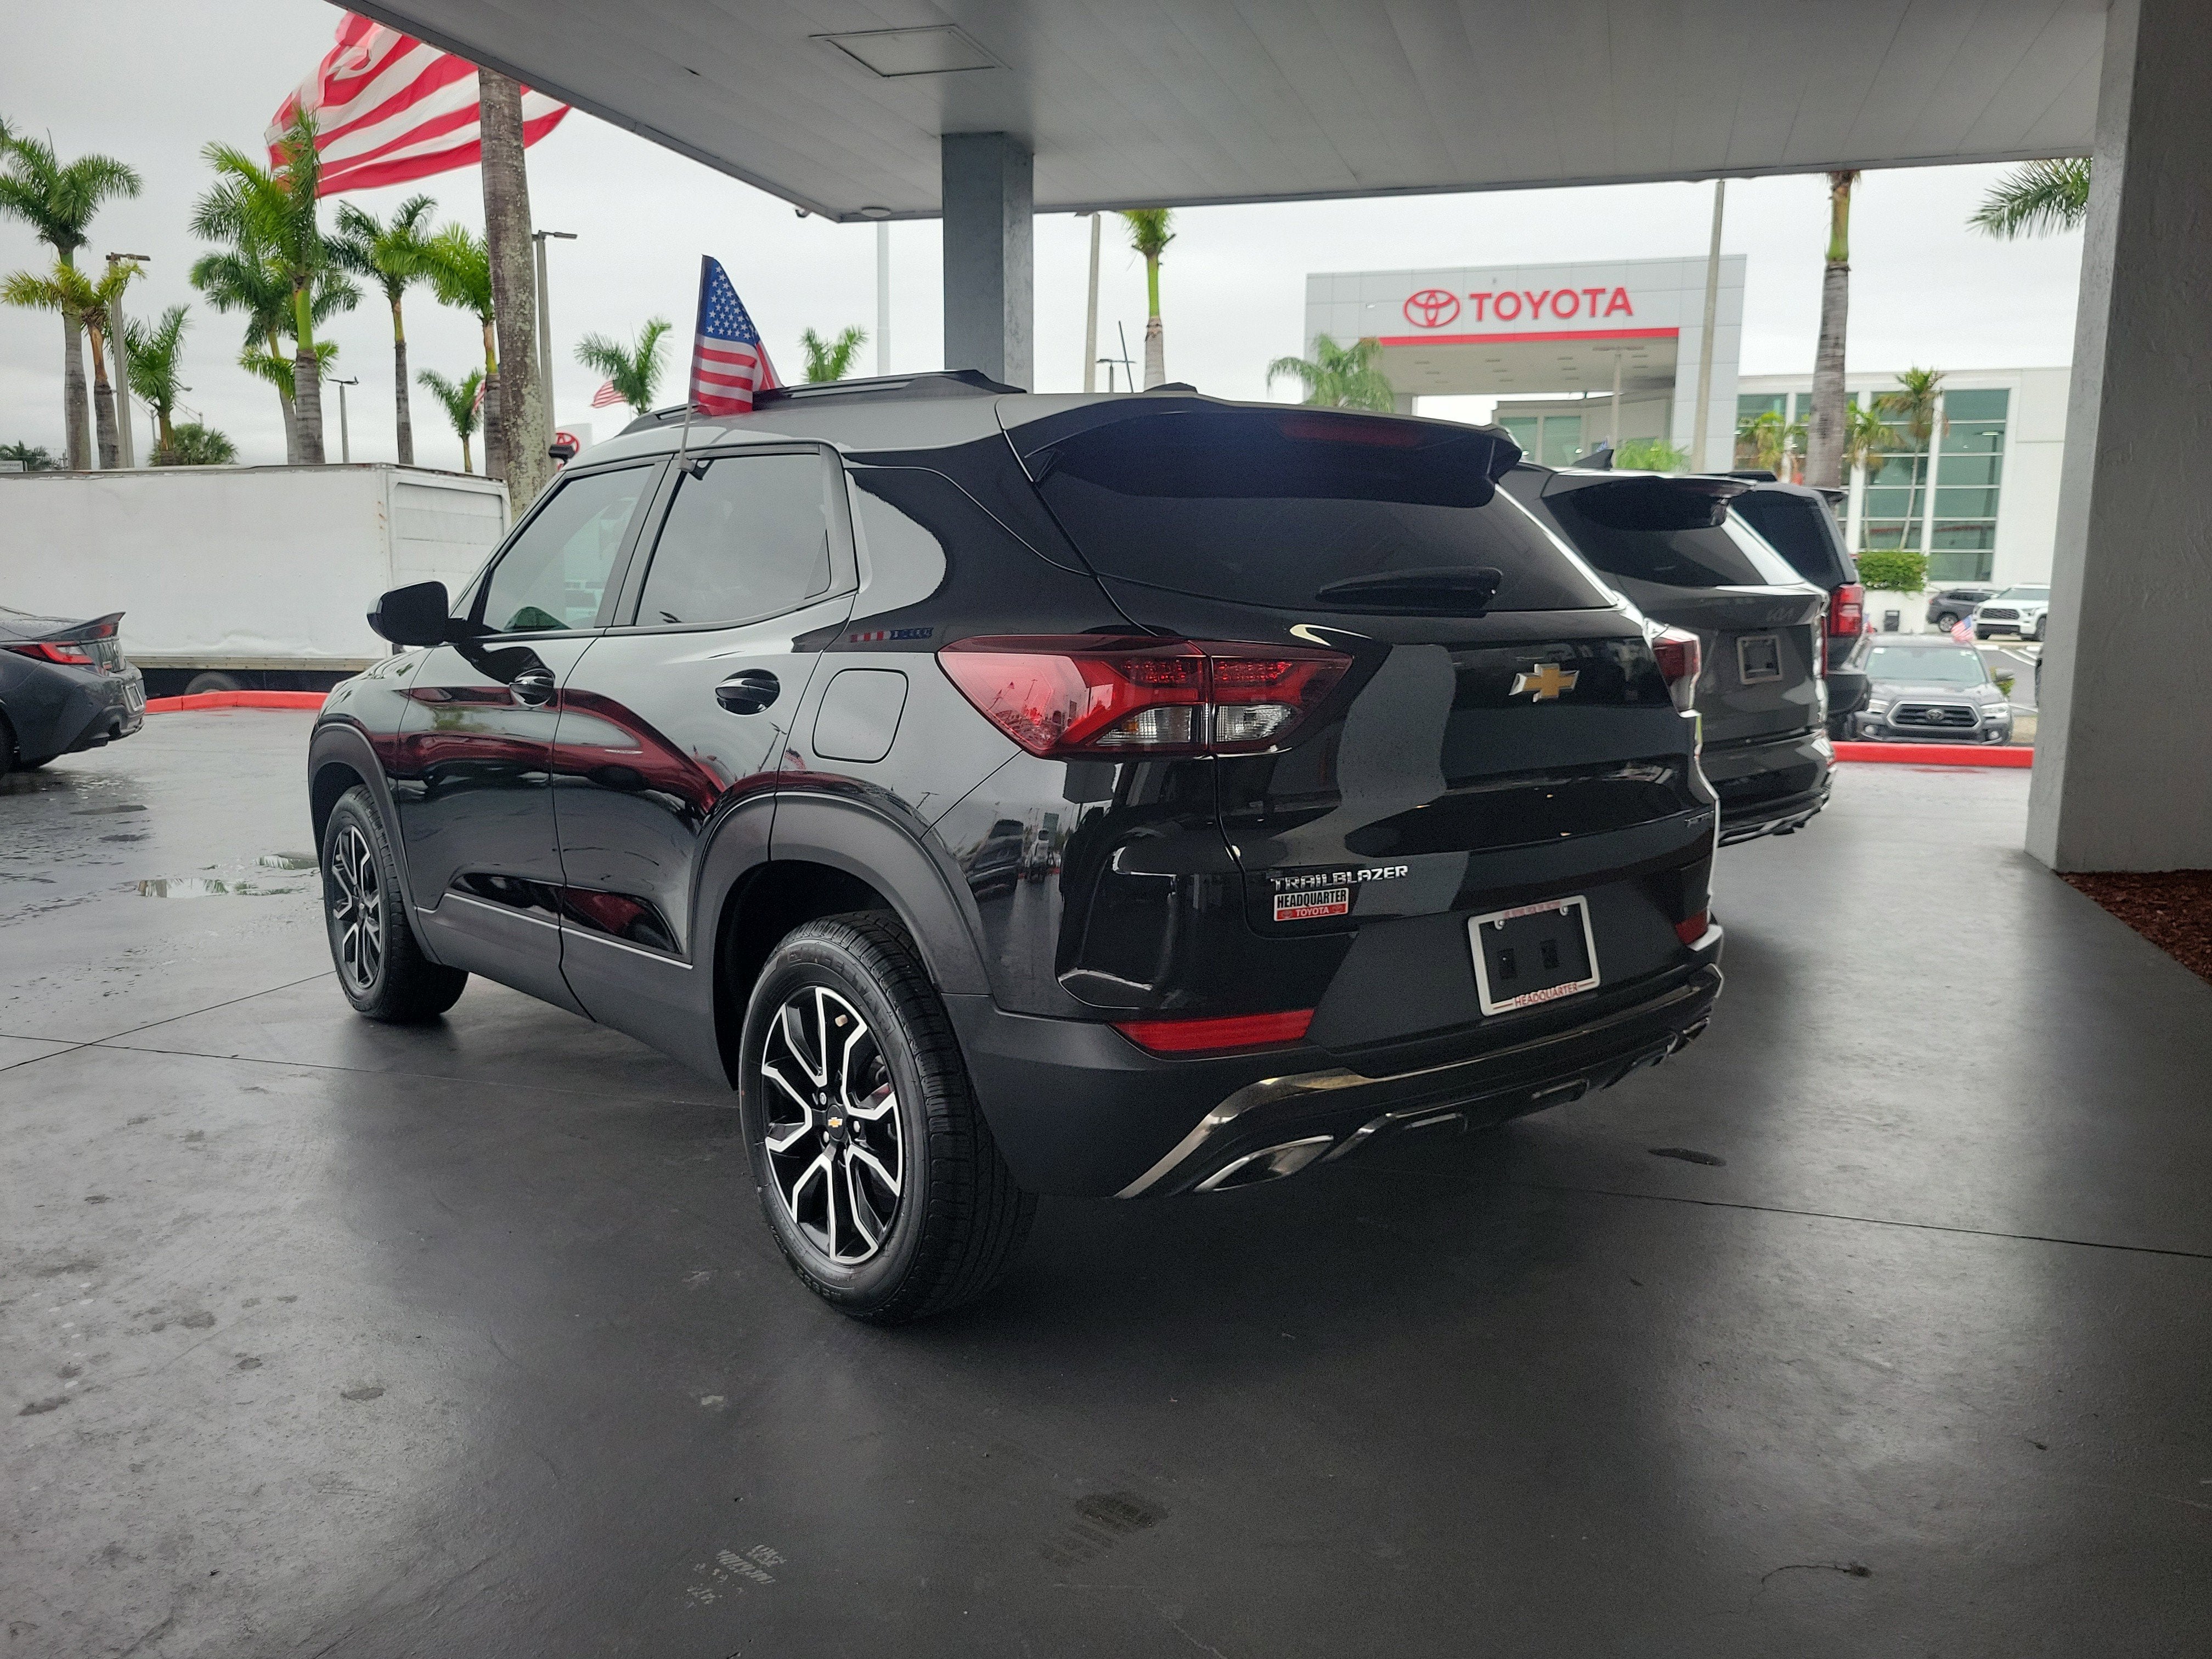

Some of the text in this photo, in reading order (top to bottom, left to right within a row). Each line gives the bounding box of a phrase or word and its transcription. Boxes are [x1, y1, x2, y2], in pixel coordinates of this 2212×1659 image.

[1470, 287, 1633, 321] TOYOTA
[1271, 866, 1408, 890] TRAILBLAZER
[1277, 891, 1346, 908] HEADQUARTER
[1295, 907, 1329, 917] TOYOTA
[1515, 983, 1578, 1007] HEADQUARTER
